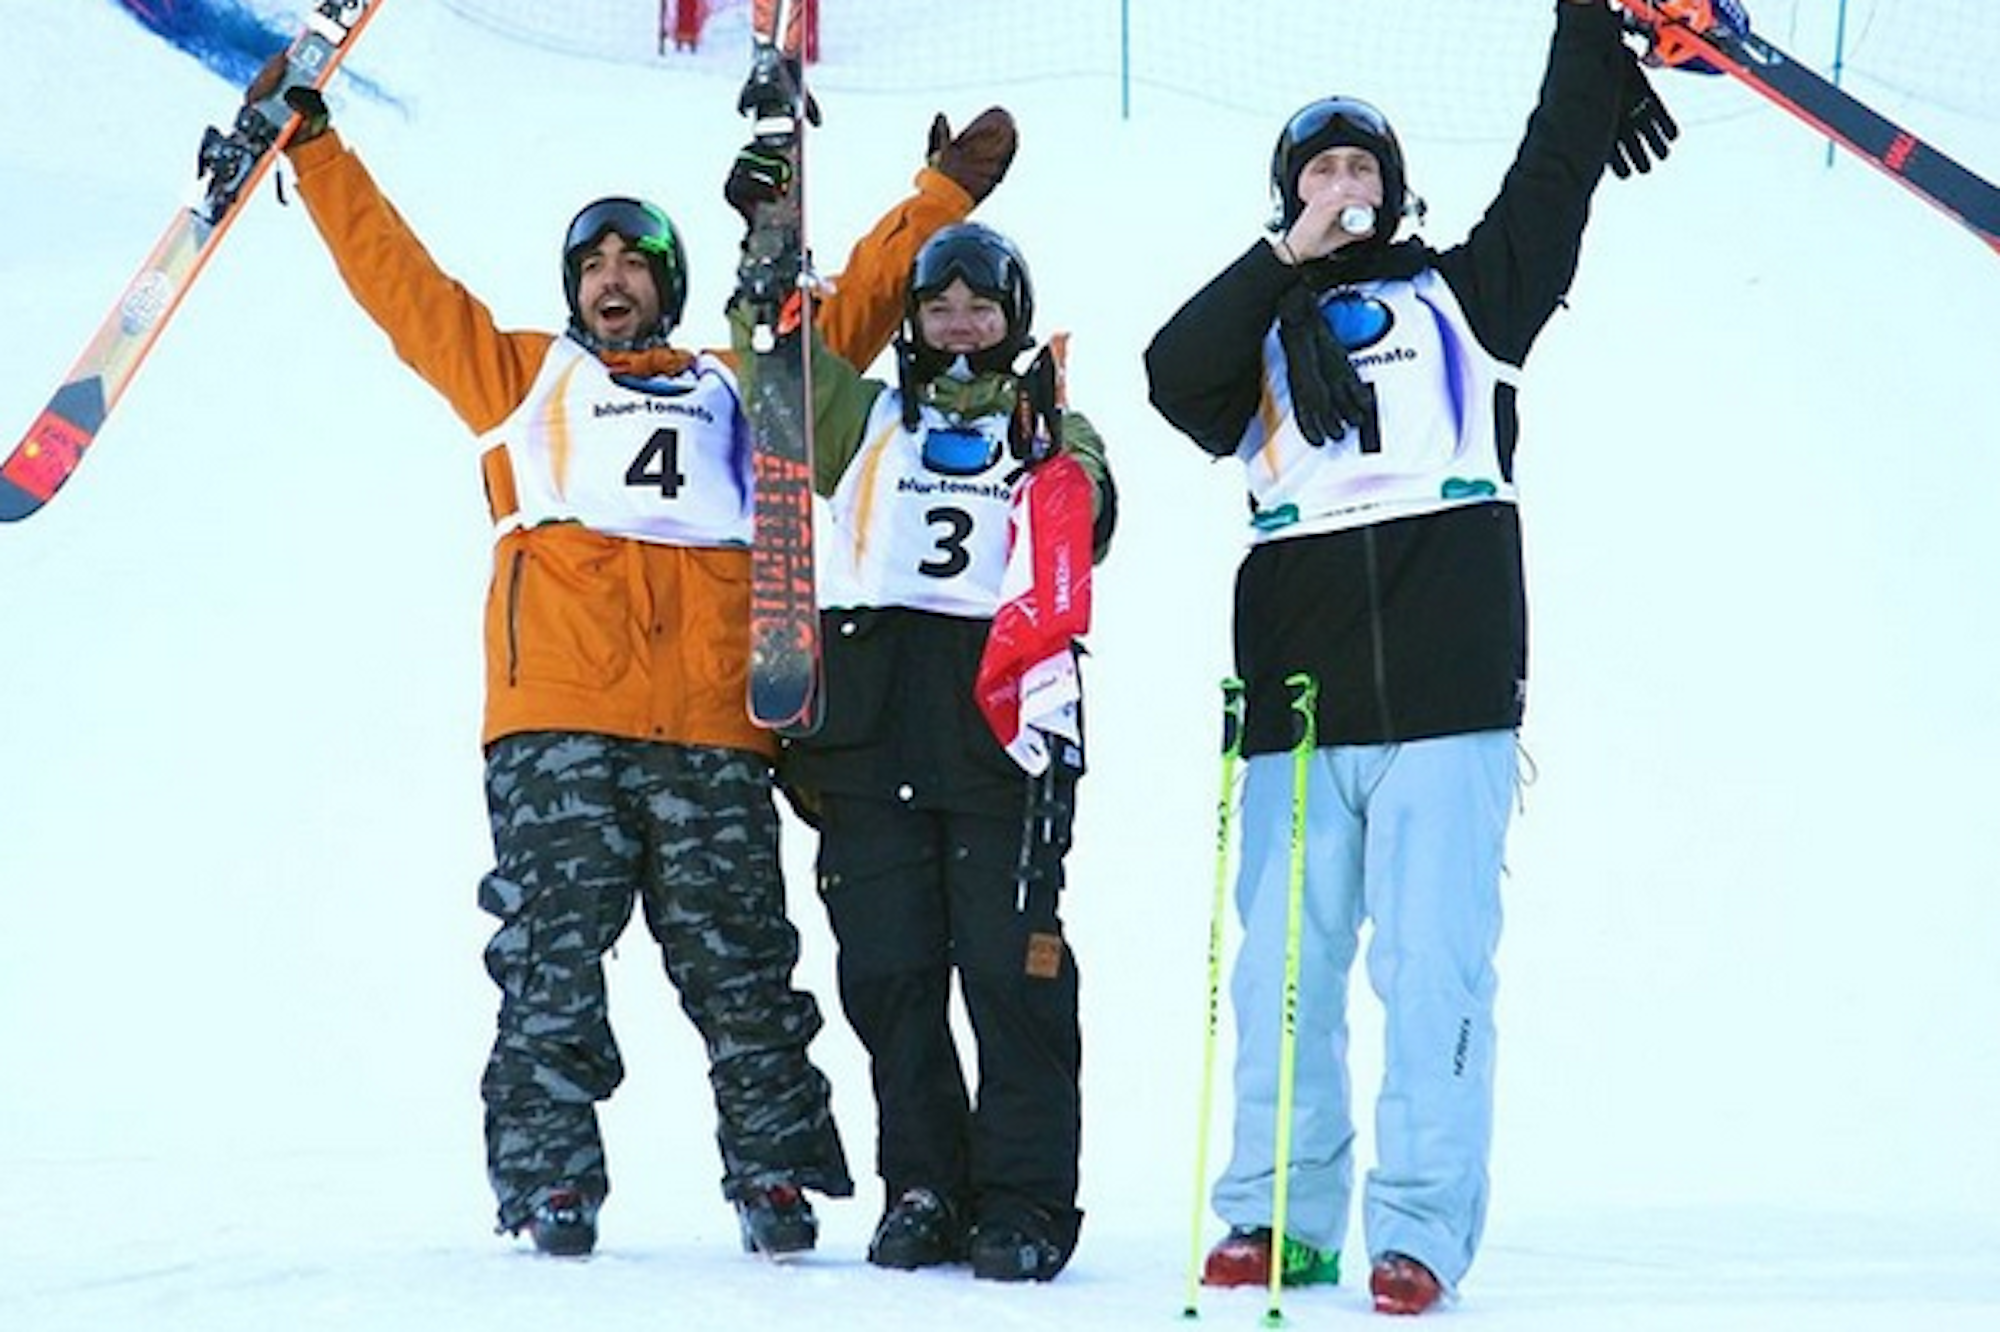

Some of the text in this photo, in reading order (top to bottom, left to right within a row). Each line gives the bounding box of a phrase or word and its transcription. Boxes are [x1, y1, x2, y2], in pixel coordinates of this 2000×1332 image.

[594, 400, 714, 424] blue-tomato
[625, 428, 684, 499] 4
[752, 452, 813, 651] ATOMIC
[919, 507, 974, 578] 3
